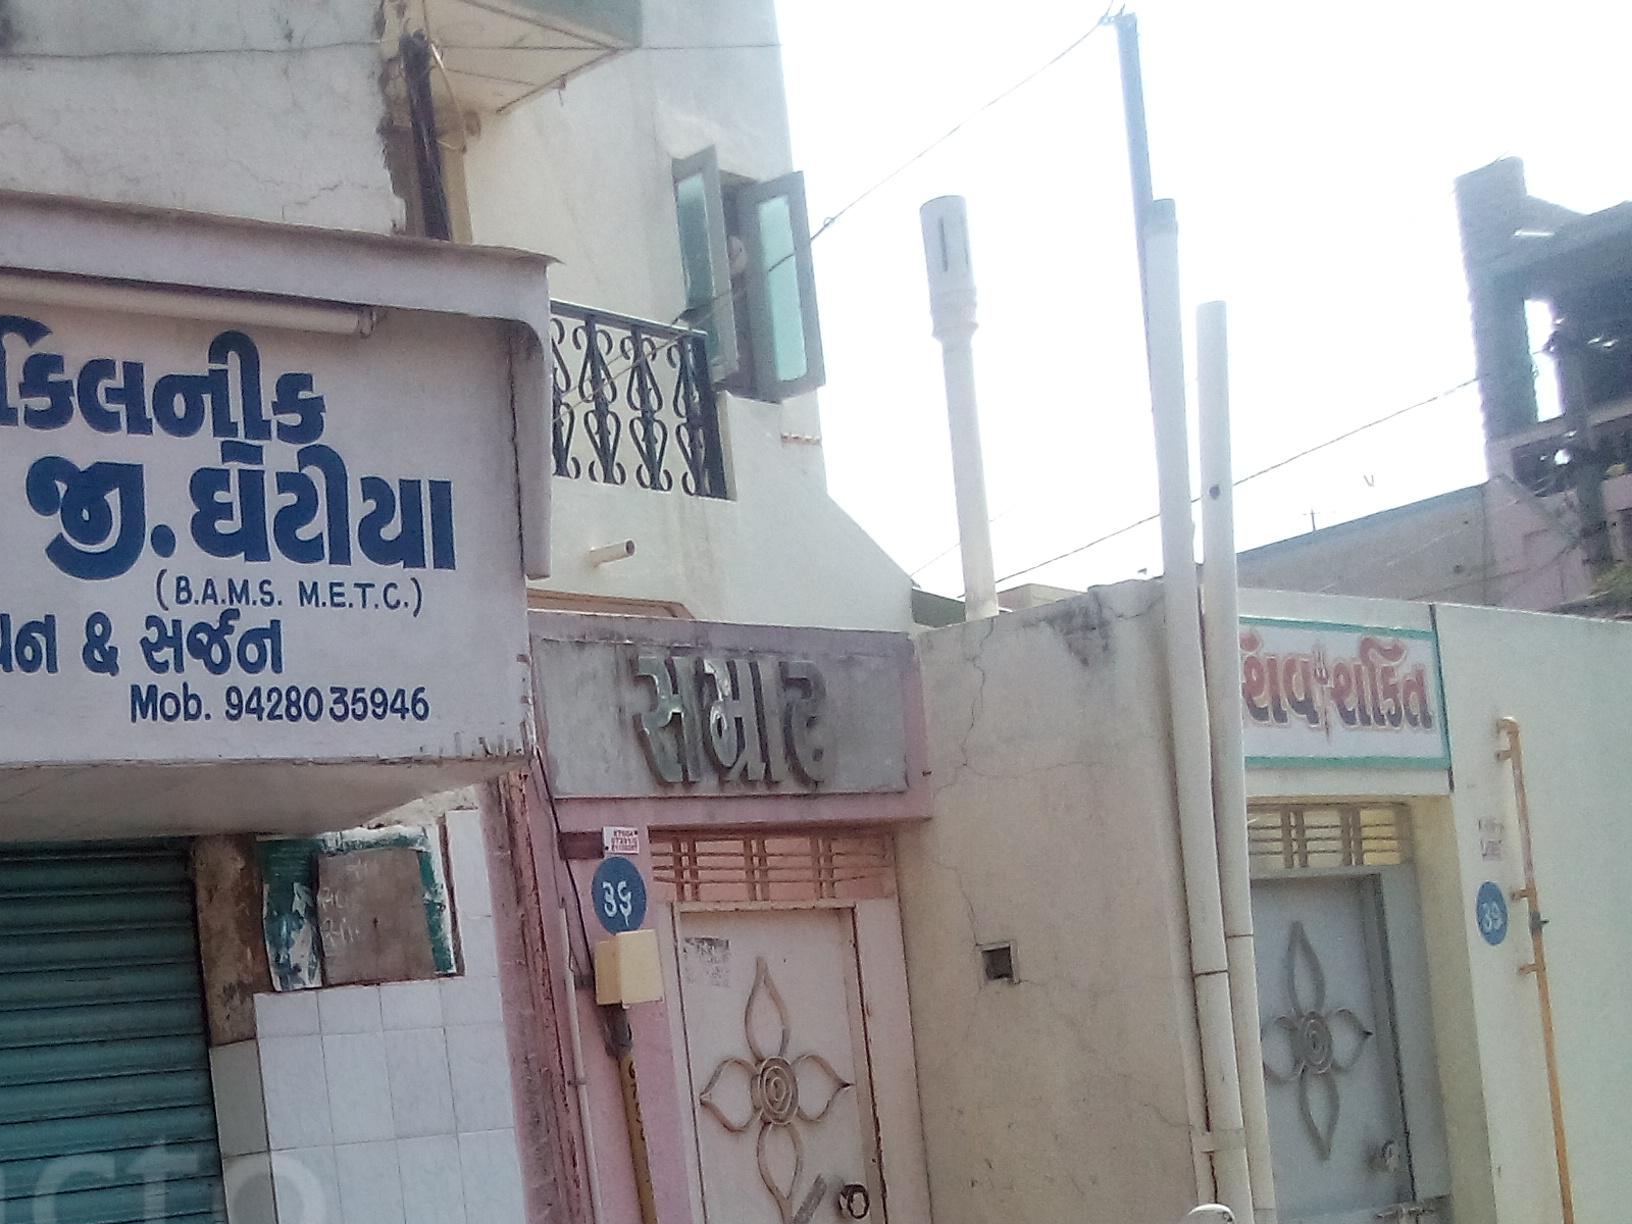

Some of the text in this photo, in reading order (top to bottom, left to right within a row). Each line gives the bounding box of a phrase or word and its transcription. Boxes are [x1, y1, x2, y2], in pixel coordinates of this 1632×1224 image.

[81, 612, 119, 676] &
[130, 684, 211, 724] Mob.
[1240, 633, 1322, 729] શવ
